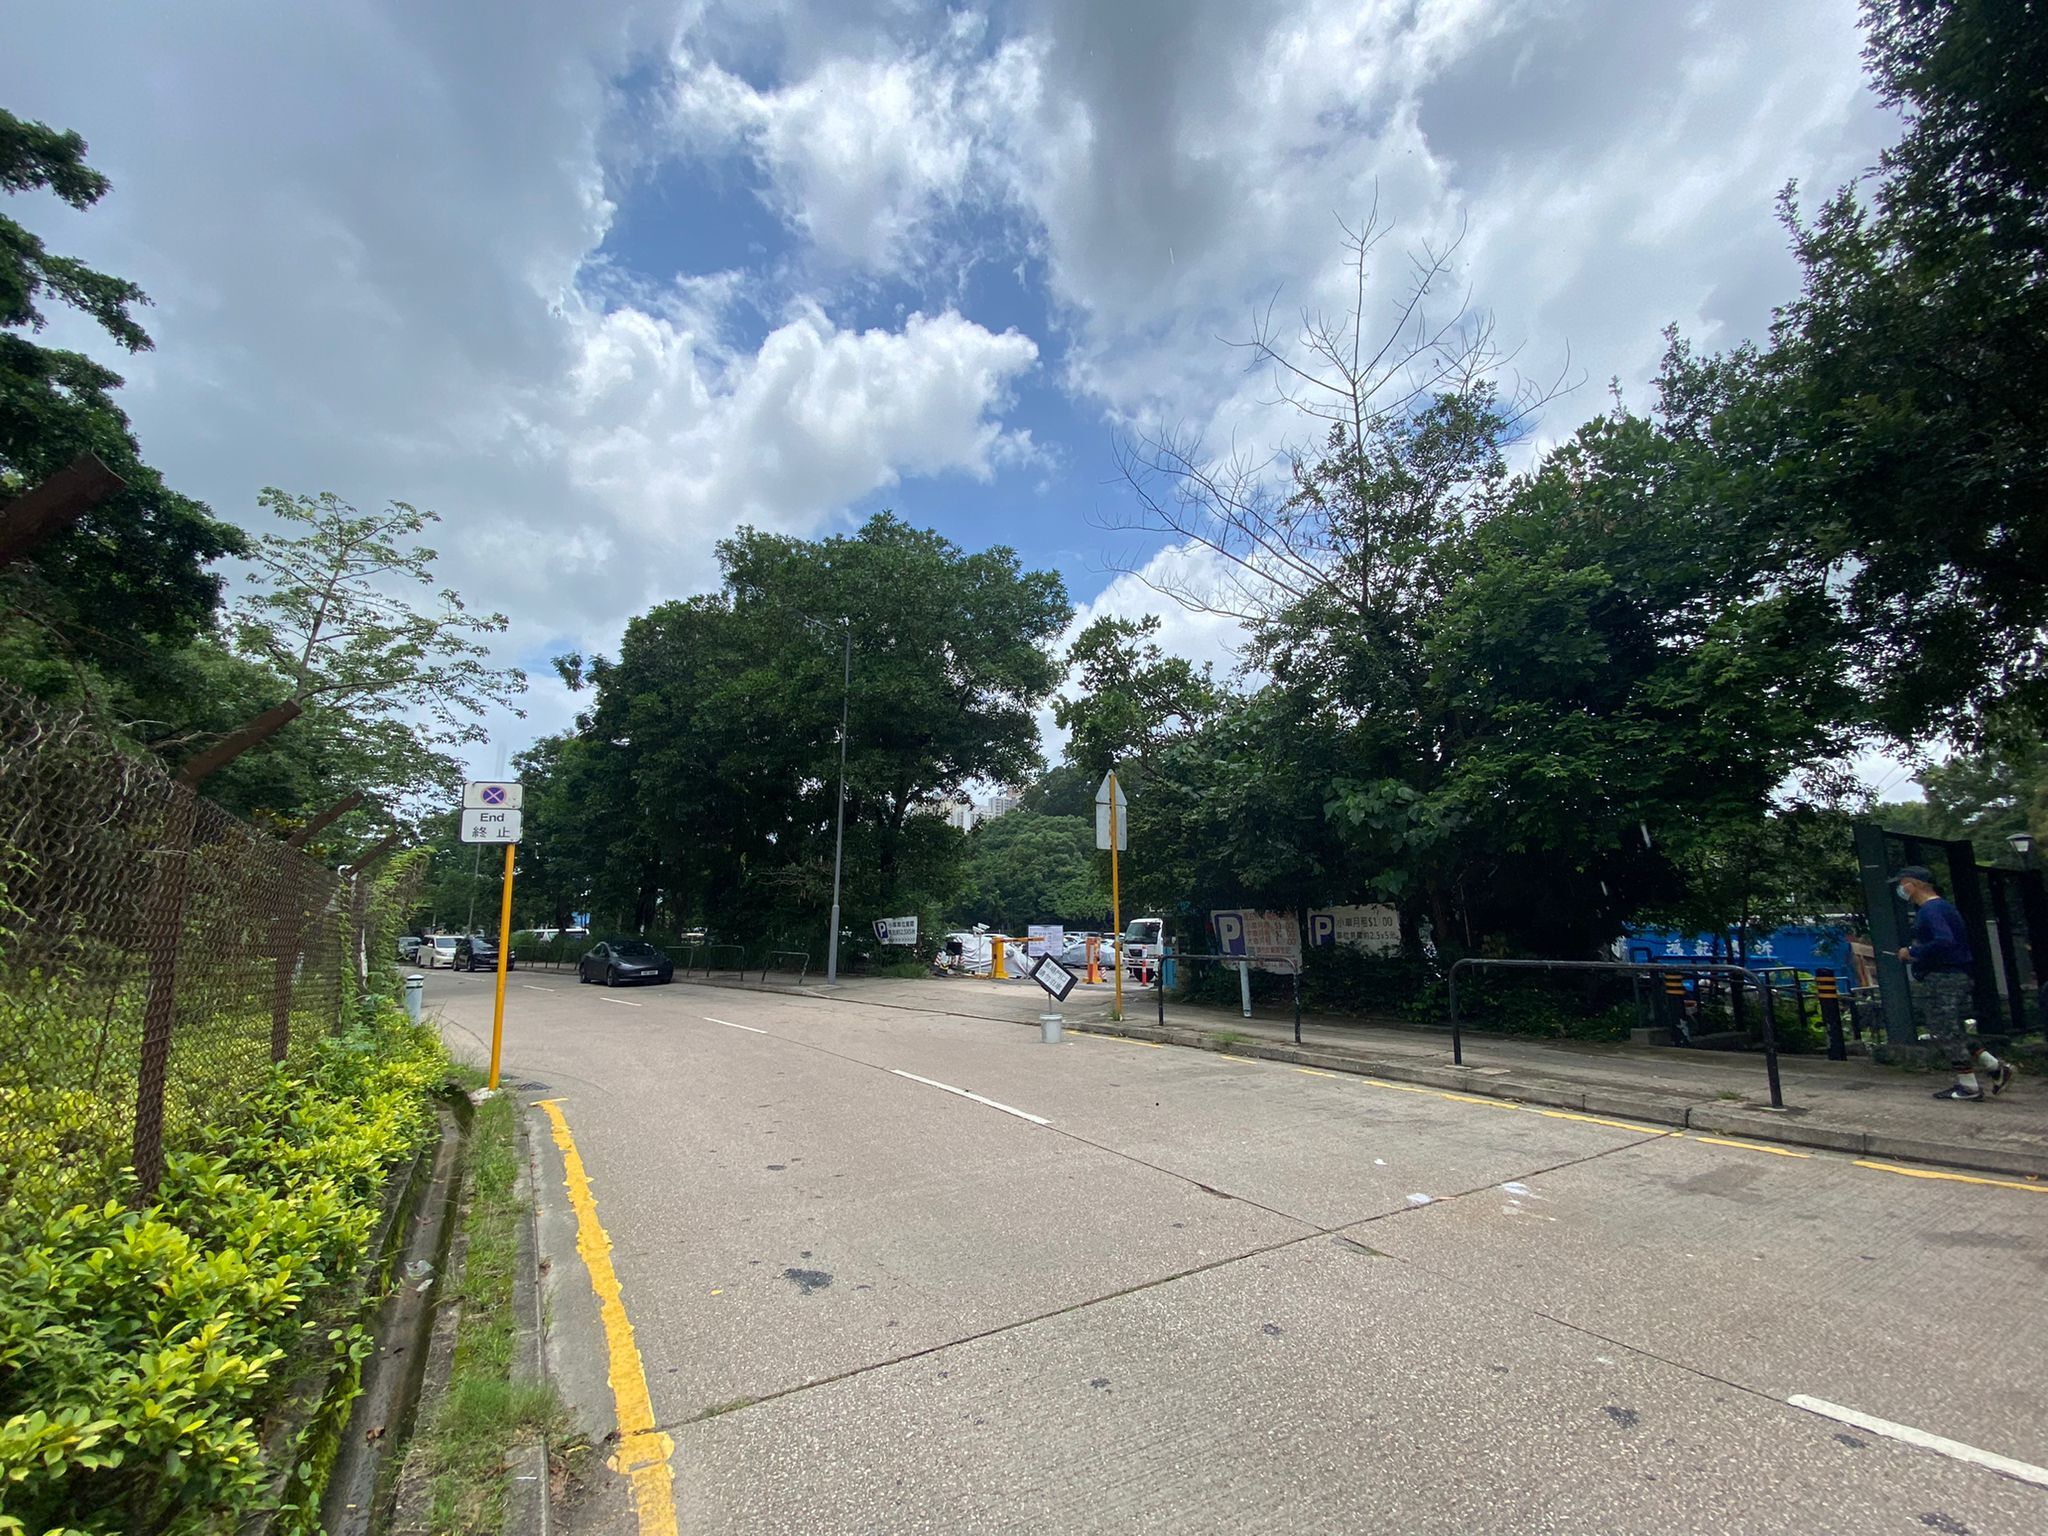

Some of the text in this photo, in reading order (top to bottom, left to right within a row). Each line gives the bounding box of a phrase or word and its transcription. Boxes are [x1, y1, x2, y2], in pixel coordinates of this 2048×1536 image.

[480, 812, 505, 822] End
[471, 826, 511, 838] 終止
[877, 922, 886, 938] P
[1218, 916, 1241, 953] P
[1315, 916, 1332, 945] P
